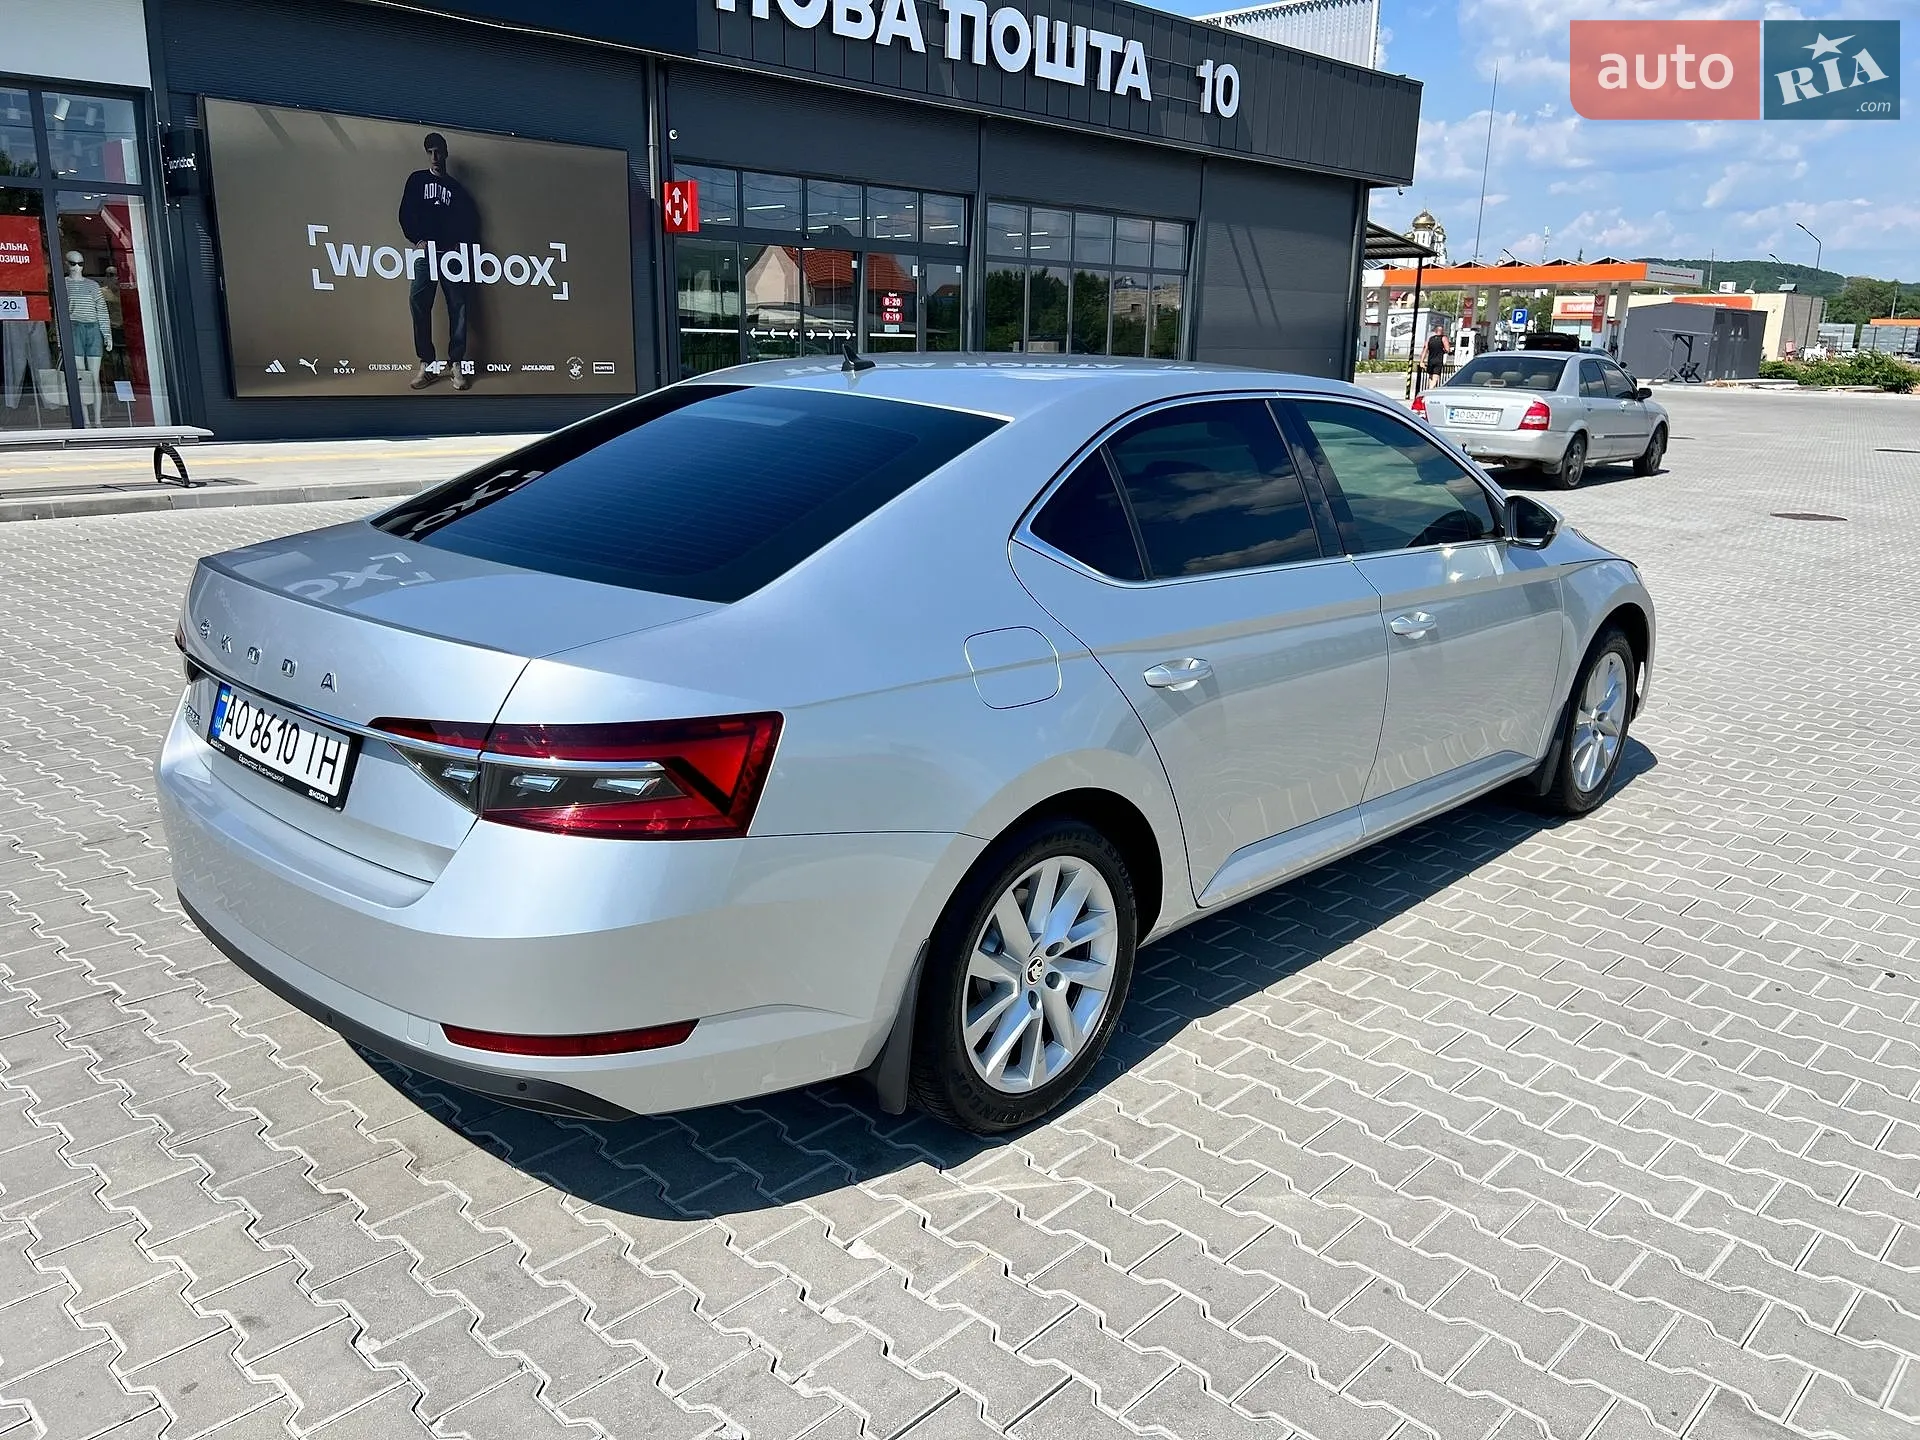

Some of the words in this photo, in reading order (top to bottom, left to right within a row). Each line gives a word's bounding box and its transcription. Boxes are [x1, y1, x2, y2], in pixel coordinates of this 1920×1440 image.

[938, 0, 1152, 101] ПОШТА
[1196, 59, 1241, 119] 10
[325, 240, 557, 288] worldbox
[368, 363, 391, 371] GUESS
[487, 363, 511, 372] ONLY
[222, 694, 250, 740] AO
[250, 707, 300, 765] 8610
[305, 731, 342, 785] IH
